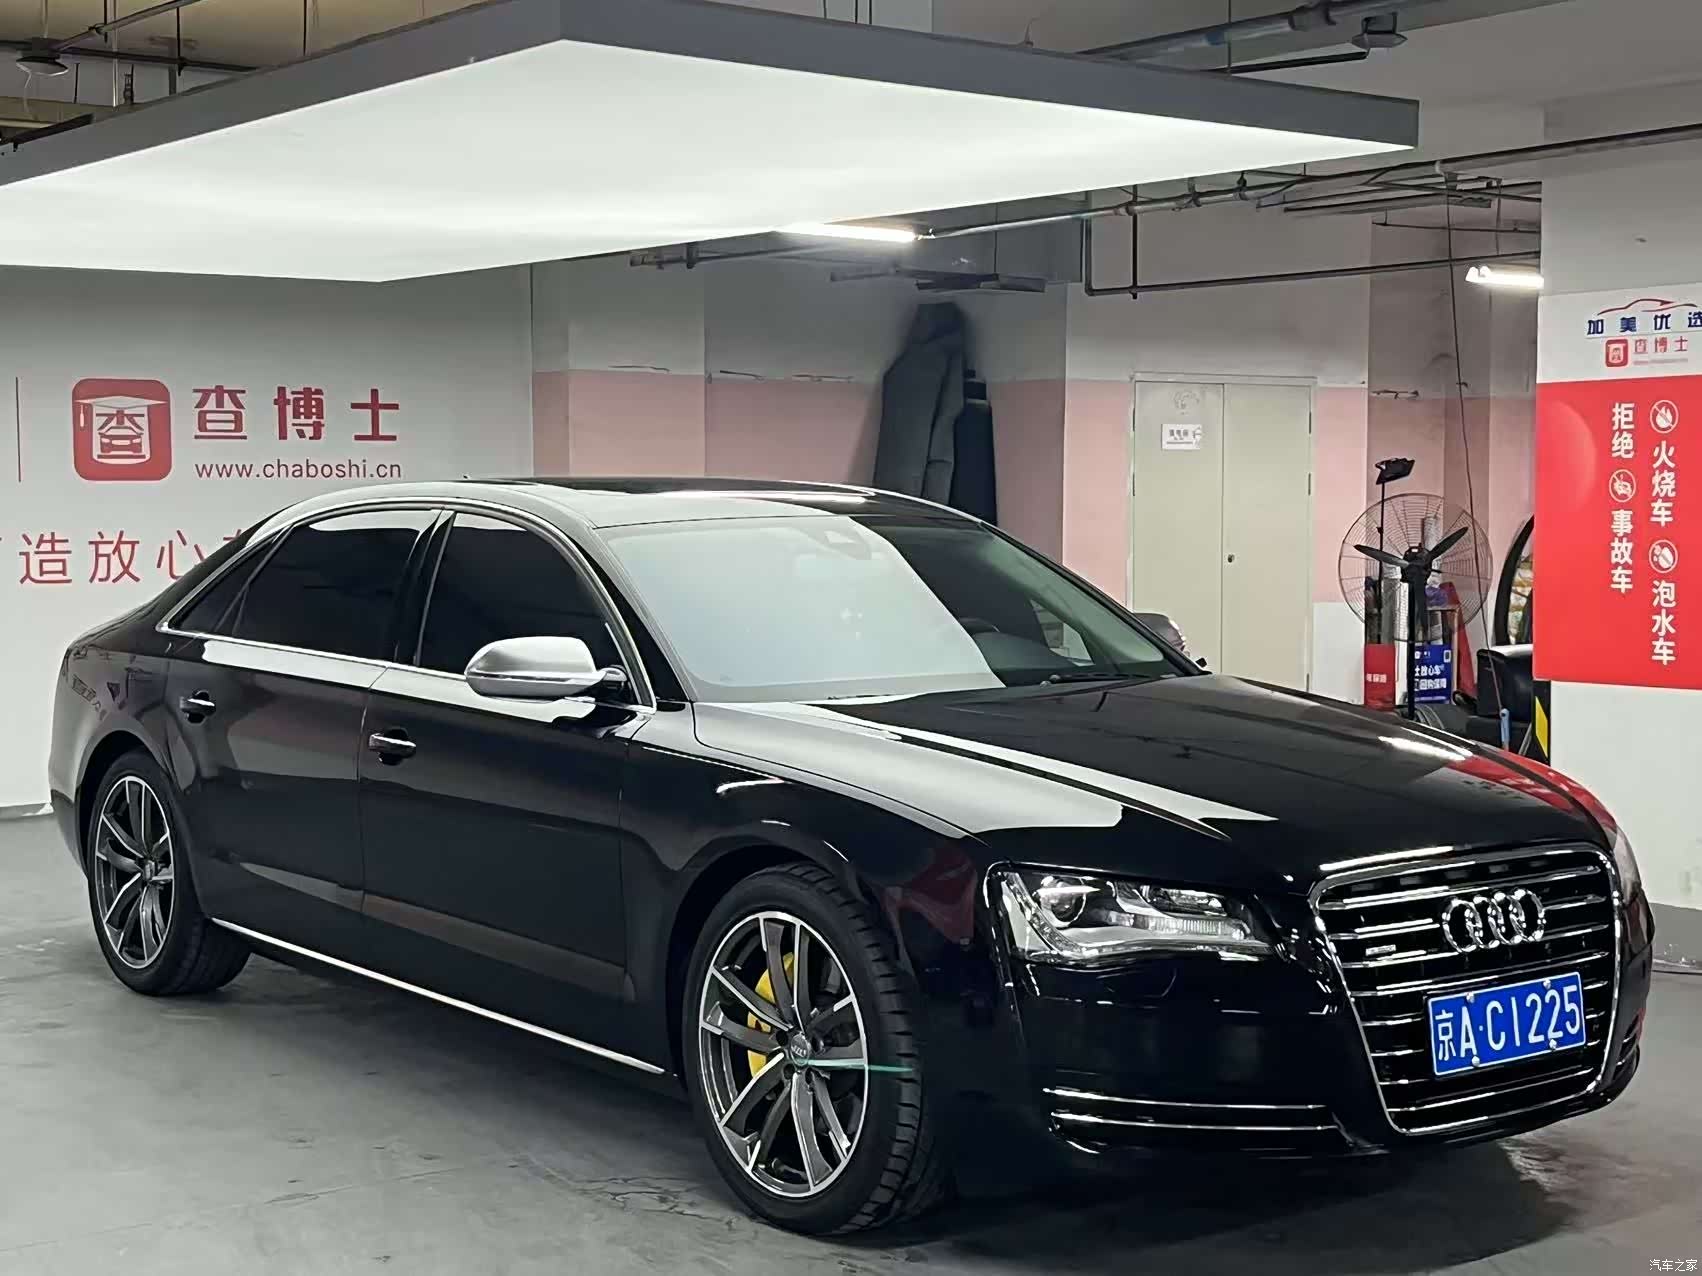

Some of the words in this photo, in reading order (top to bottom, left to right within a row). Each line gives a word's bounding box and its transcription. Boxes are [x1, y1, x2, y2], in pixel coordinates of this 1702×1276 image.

[1587, 311, 1702, 335] 加美优选
[1633, 336, 1688, 354] 查博士
[192, 385, 400, 441] 查博士
[1611, 402, 1635, 458] 拒绝
[194, 458, 402, 478] www.chaboshi.cn
[1650, 440, 1676, 527] 火烧车
[0, 529, 242, 584] 造放心
[1610, 509, 1634, 593] 事故车
[1651, 579, 1676, 665] 泡水车
